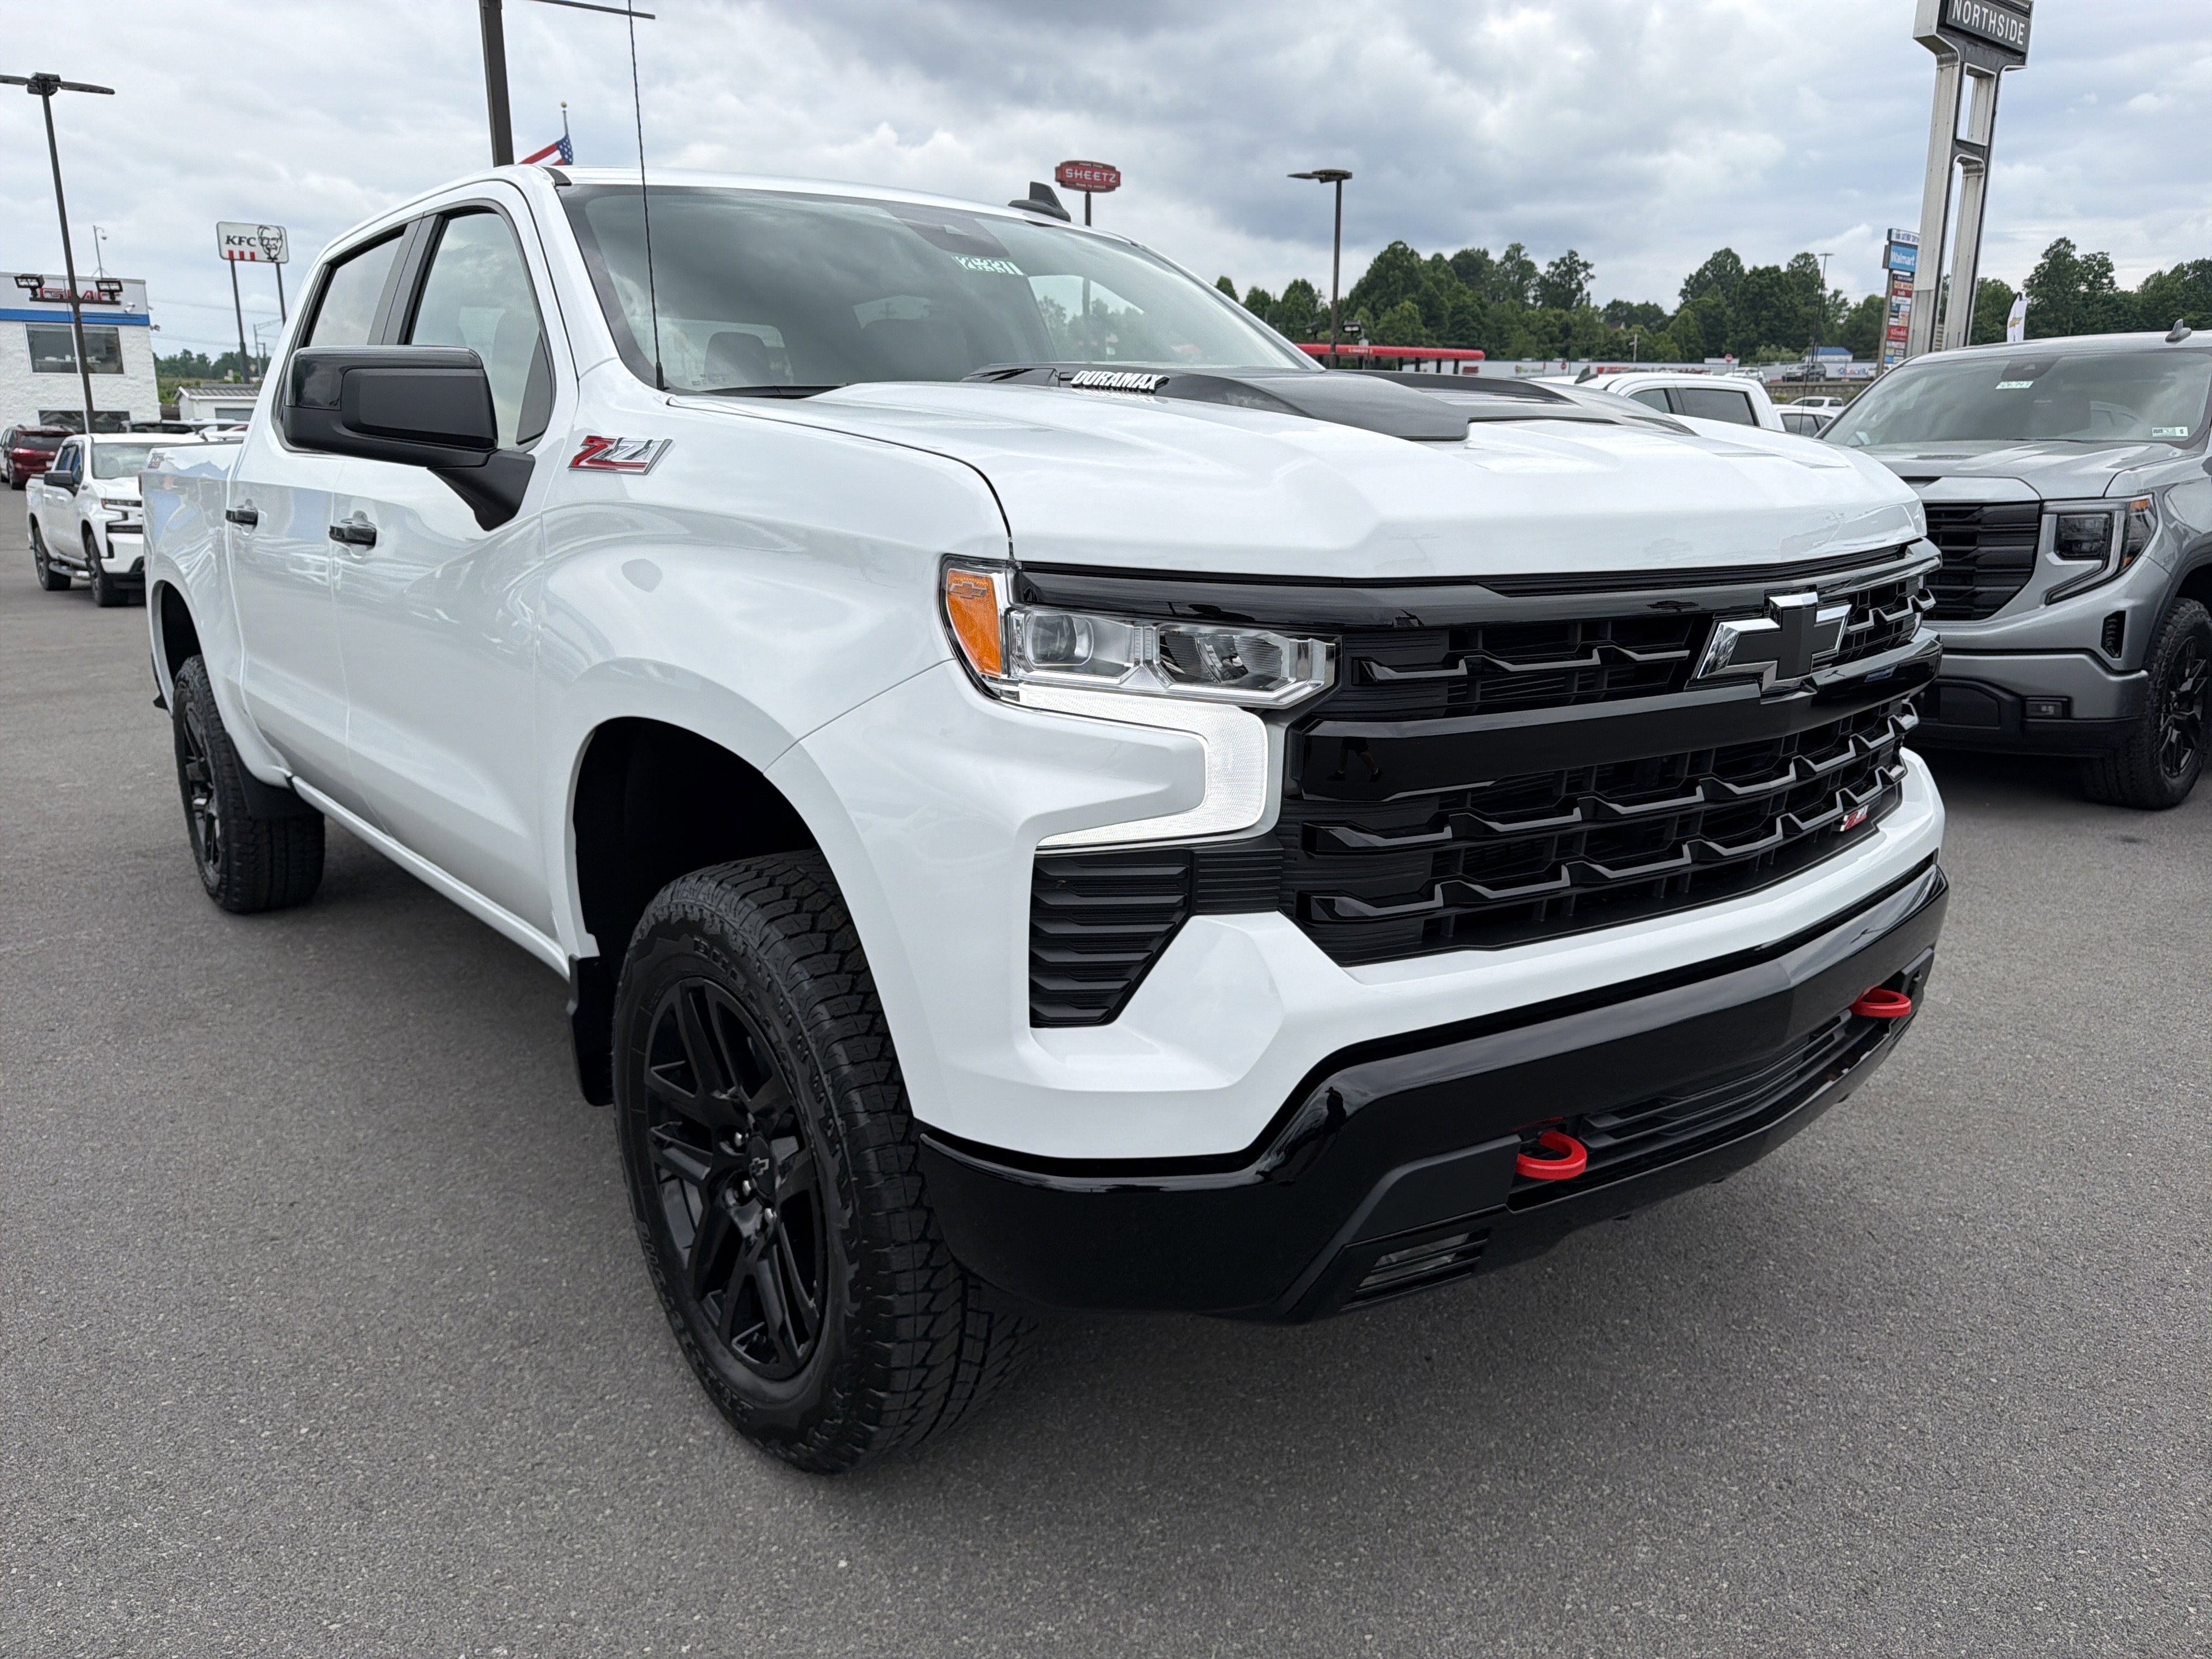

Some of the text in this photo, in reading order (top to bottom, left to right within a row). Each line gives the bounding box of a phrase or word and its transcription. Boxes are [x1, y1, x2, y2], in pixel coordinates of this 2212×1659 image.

[1952, 0, 2025, 45] NORTHSIDE
[1065, 168, 1116, 183] SHEETZ
[225, 235, 256, 247] KFC
[1070, 370, 1164, 391] DURAMAX
[567, 435, 674, 476] Z71
